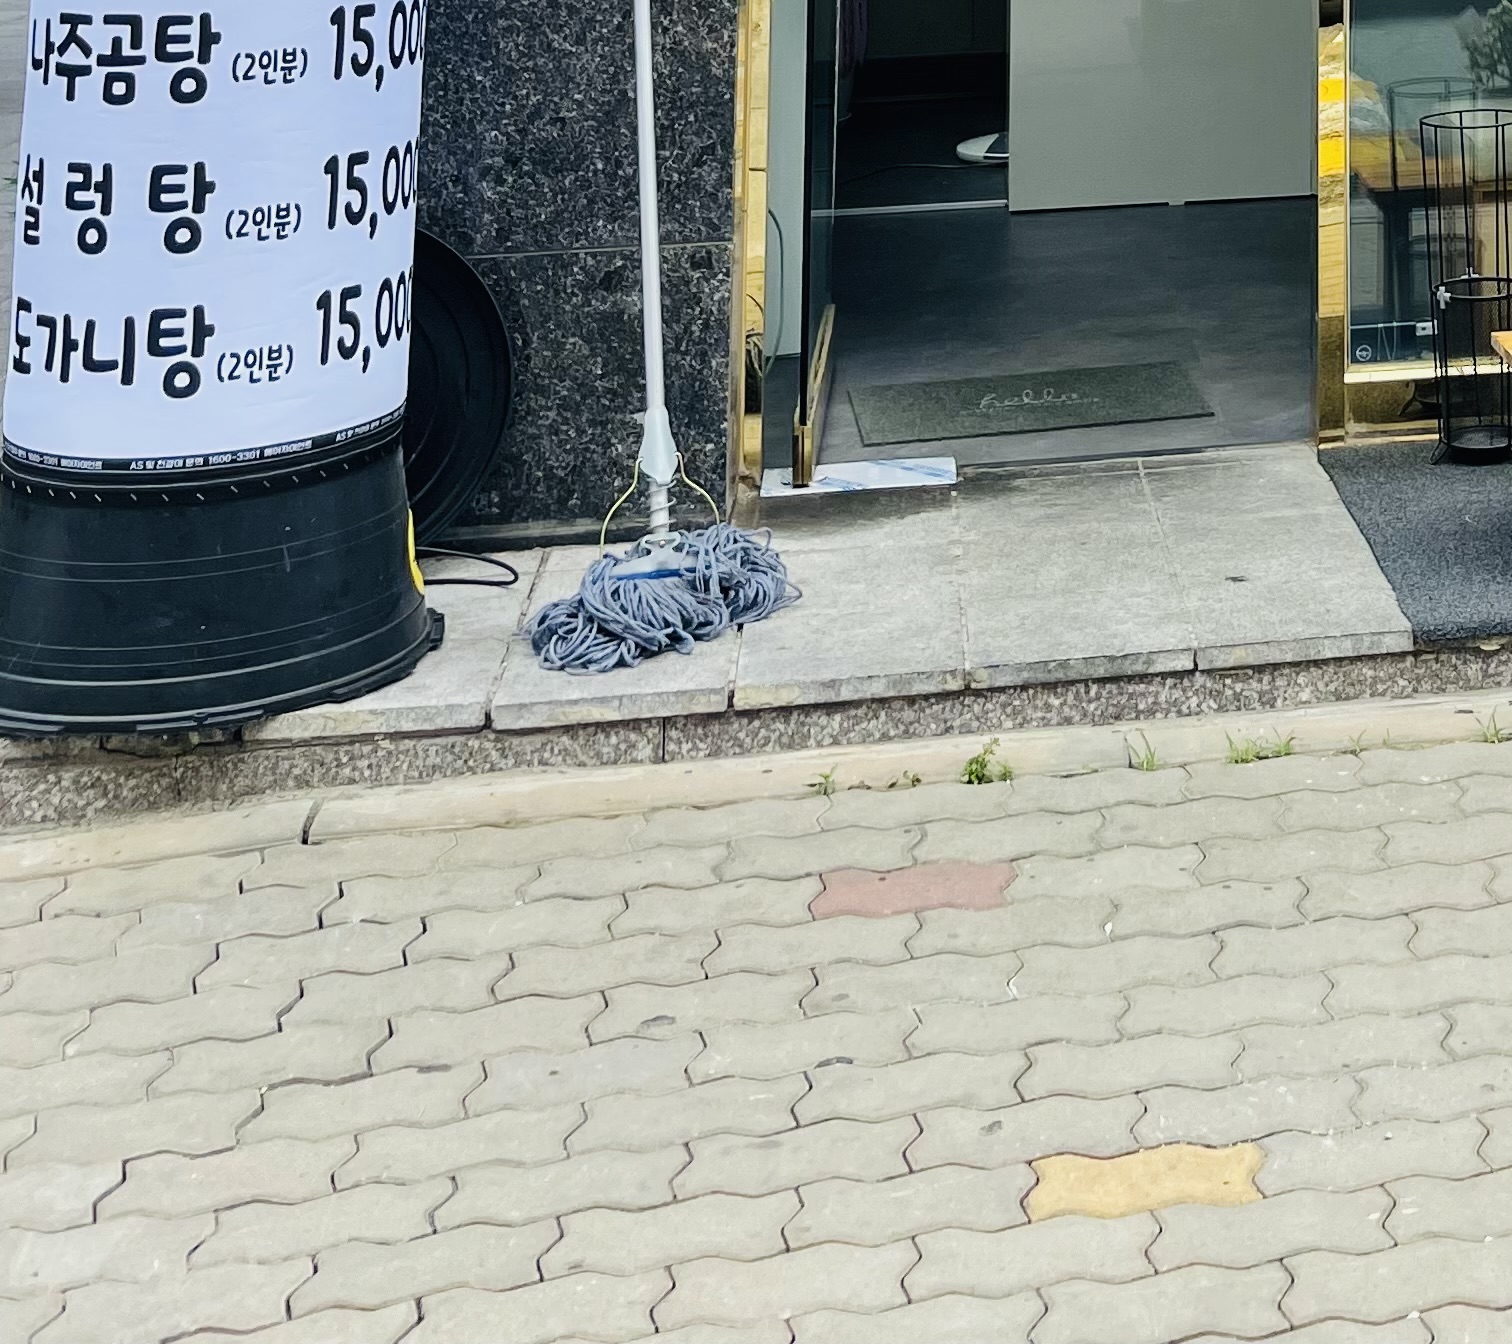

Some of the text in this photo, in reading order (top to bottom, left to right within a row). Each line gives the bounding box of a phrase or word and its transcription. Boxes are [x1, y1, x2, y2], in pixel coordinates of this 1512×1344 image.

[232, 47, 308, 84] (2인분)
[225, 203, 302, 241] (2인분)
[216, 344, 293, 383] (2인분)
[129, 460, 144, 471] AS
[208, 449, 260, 465] 1600-3301
